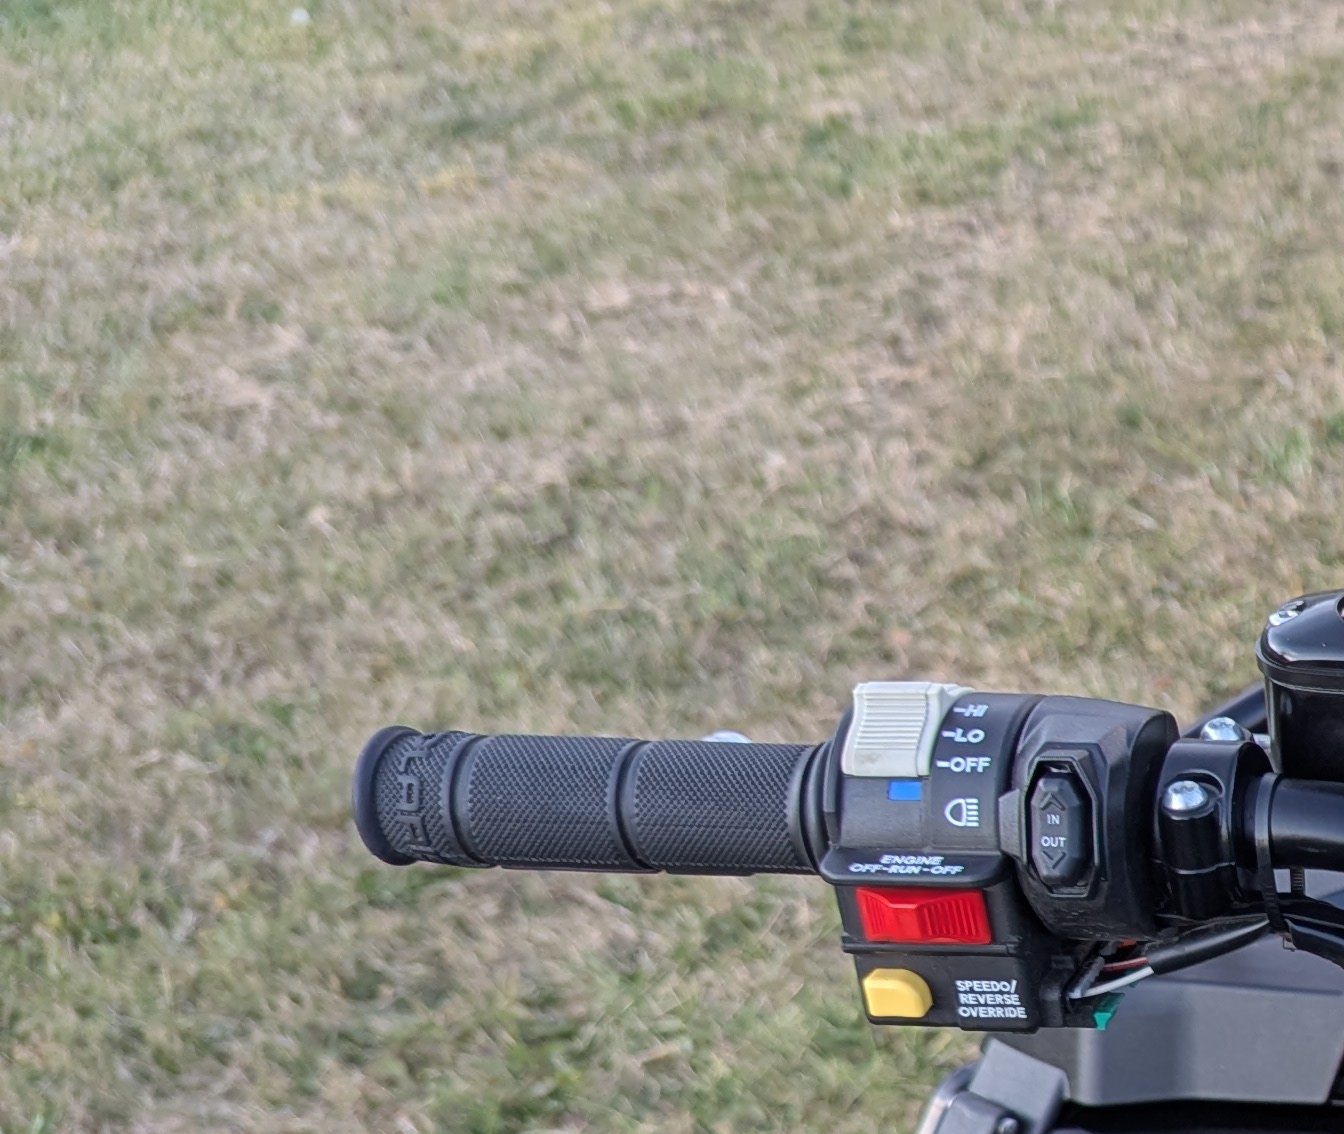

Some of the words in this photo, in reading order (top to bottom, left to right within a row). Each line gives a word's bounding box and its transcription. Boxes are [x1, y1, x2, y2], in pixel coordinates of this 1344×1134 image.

[964, 705, 989, 717] HI
[954, 728, 985, 743] LO
[950, 757, 992, 773] OFF
[1046, 814, 1060, 825] IN
[1041, 836, 1067, 848] OUT
[880, 854, 945, 866] ENGINE
[955, 980, 1017, 993] SPEEDO/
[958, 993, 1022, 1006] REVERSE
[958, 1006, 1028, 1019] OVERRIDE
